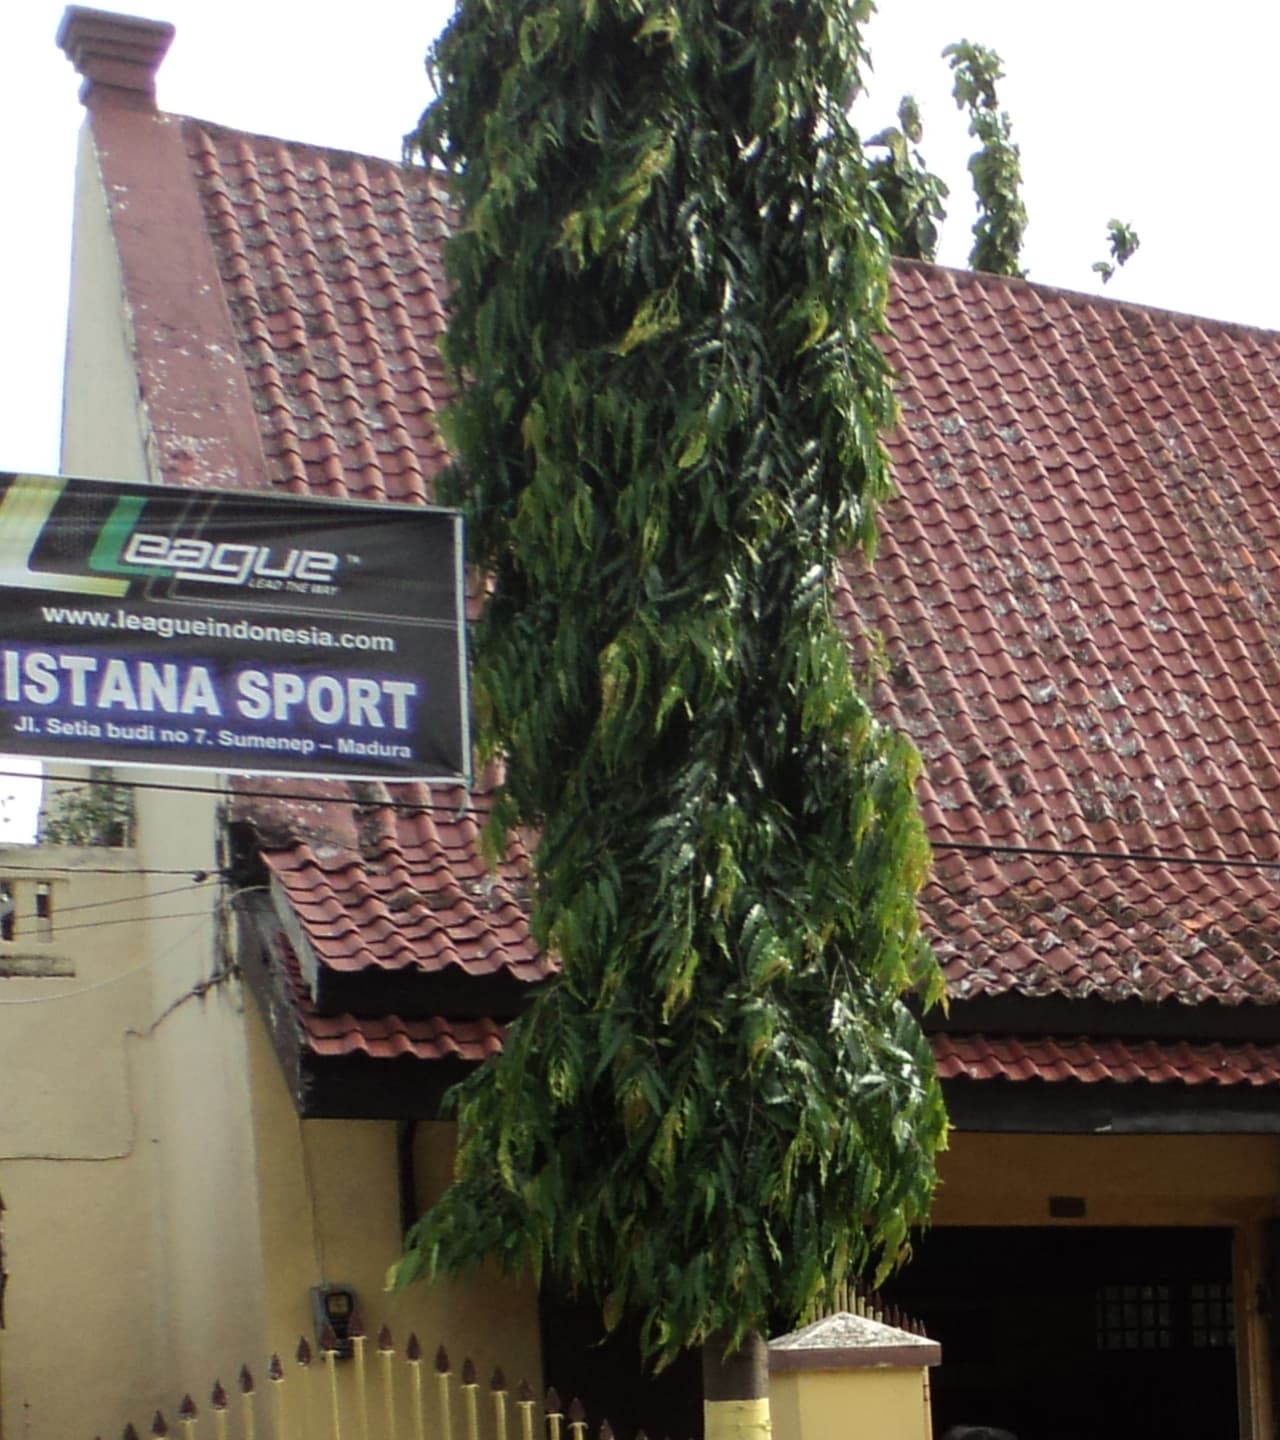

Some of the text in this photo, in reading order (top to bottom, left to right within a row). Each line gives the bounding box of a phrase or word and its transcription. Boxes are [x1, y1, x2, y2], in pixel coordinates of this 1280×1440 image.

[42, 606, 395, 653] www.leagueindonesia.com
[2, 650, 417, 731] ISTANA SPORT
[46, 717, 101, 737] Setia
[106, 722, 155, 742] budi
[160, 729, 190, 744] no
[192, 727, 214, 746] 7.
[218, 730, 315, 755] Sumenep
[337, 738, 412, 759] Madura
